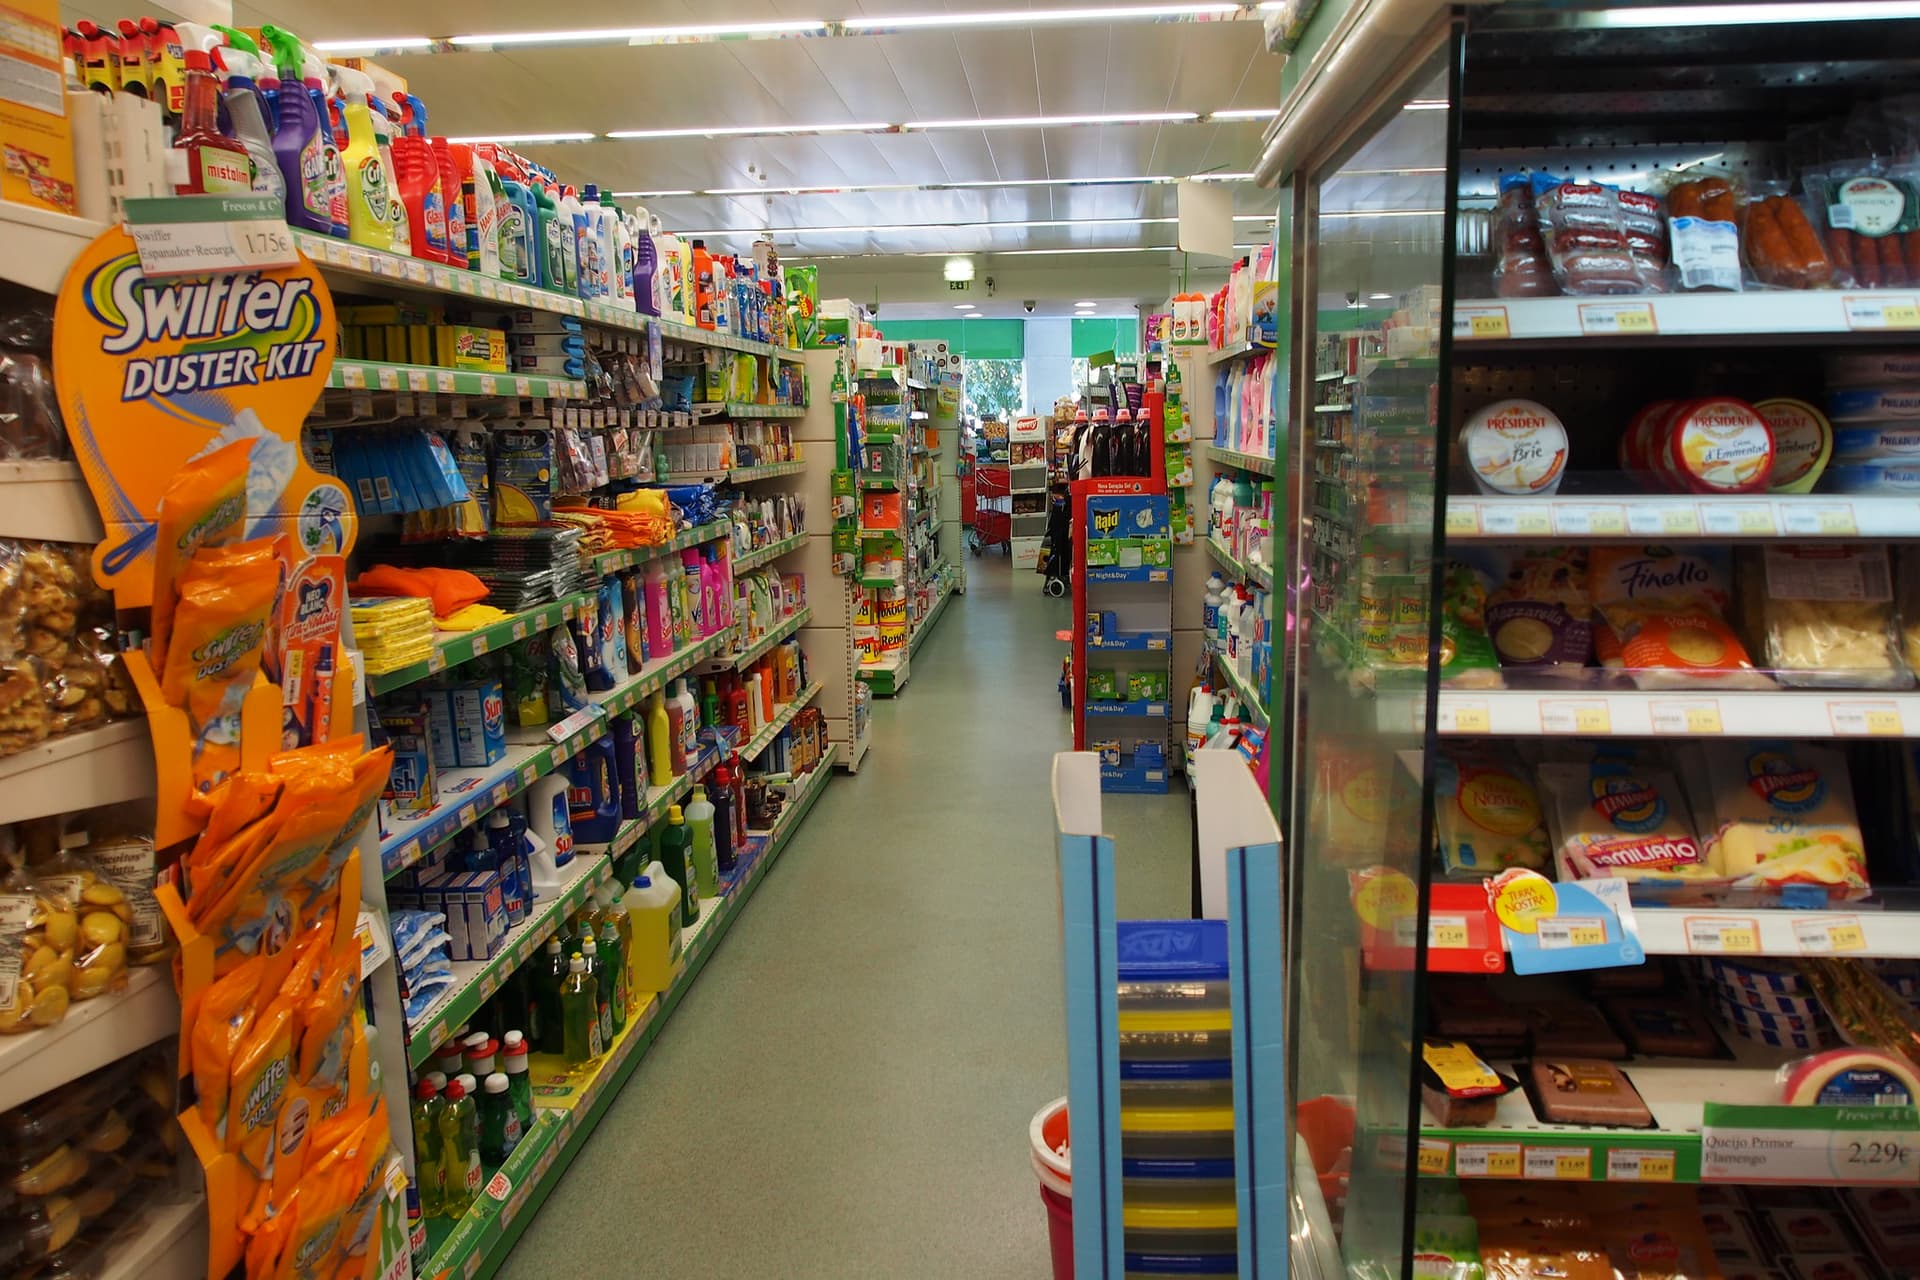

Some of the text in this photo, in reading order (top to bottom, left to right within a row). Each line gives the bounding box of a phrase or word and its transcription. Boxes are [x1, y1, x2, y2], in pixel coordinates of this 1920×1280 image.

[207, 165, 249, 184] mistolim
[135, 230, 171, 243] Swiffer
[102, 264, 313, 353] Swiffer
[121, 339, 325, 402] DUSTER KIT
[1487, 416, 1546, 431] PRÉSIDENT
[1512, 446, 1544, 463] Brie
[1095, 511, 1119, 530] Raid
[1618, 559, 1709, 598] Finello
[305, 588, 321, 601] NEO
[300, 597, 325, 616] BLANC
[1487, 606, 1565, 628] Mozzarella
[482, 695, 503, 721] Sun
[555, 834, 574, 856] Sun
[1504, 893, 1548, 913] NOSTRA
[1508, 887, 1537, 900] TERRA
[1706, 1135, 1795, 1150] Queijo Primor
[1705, 1151, 1767, 1166] Flamengo
